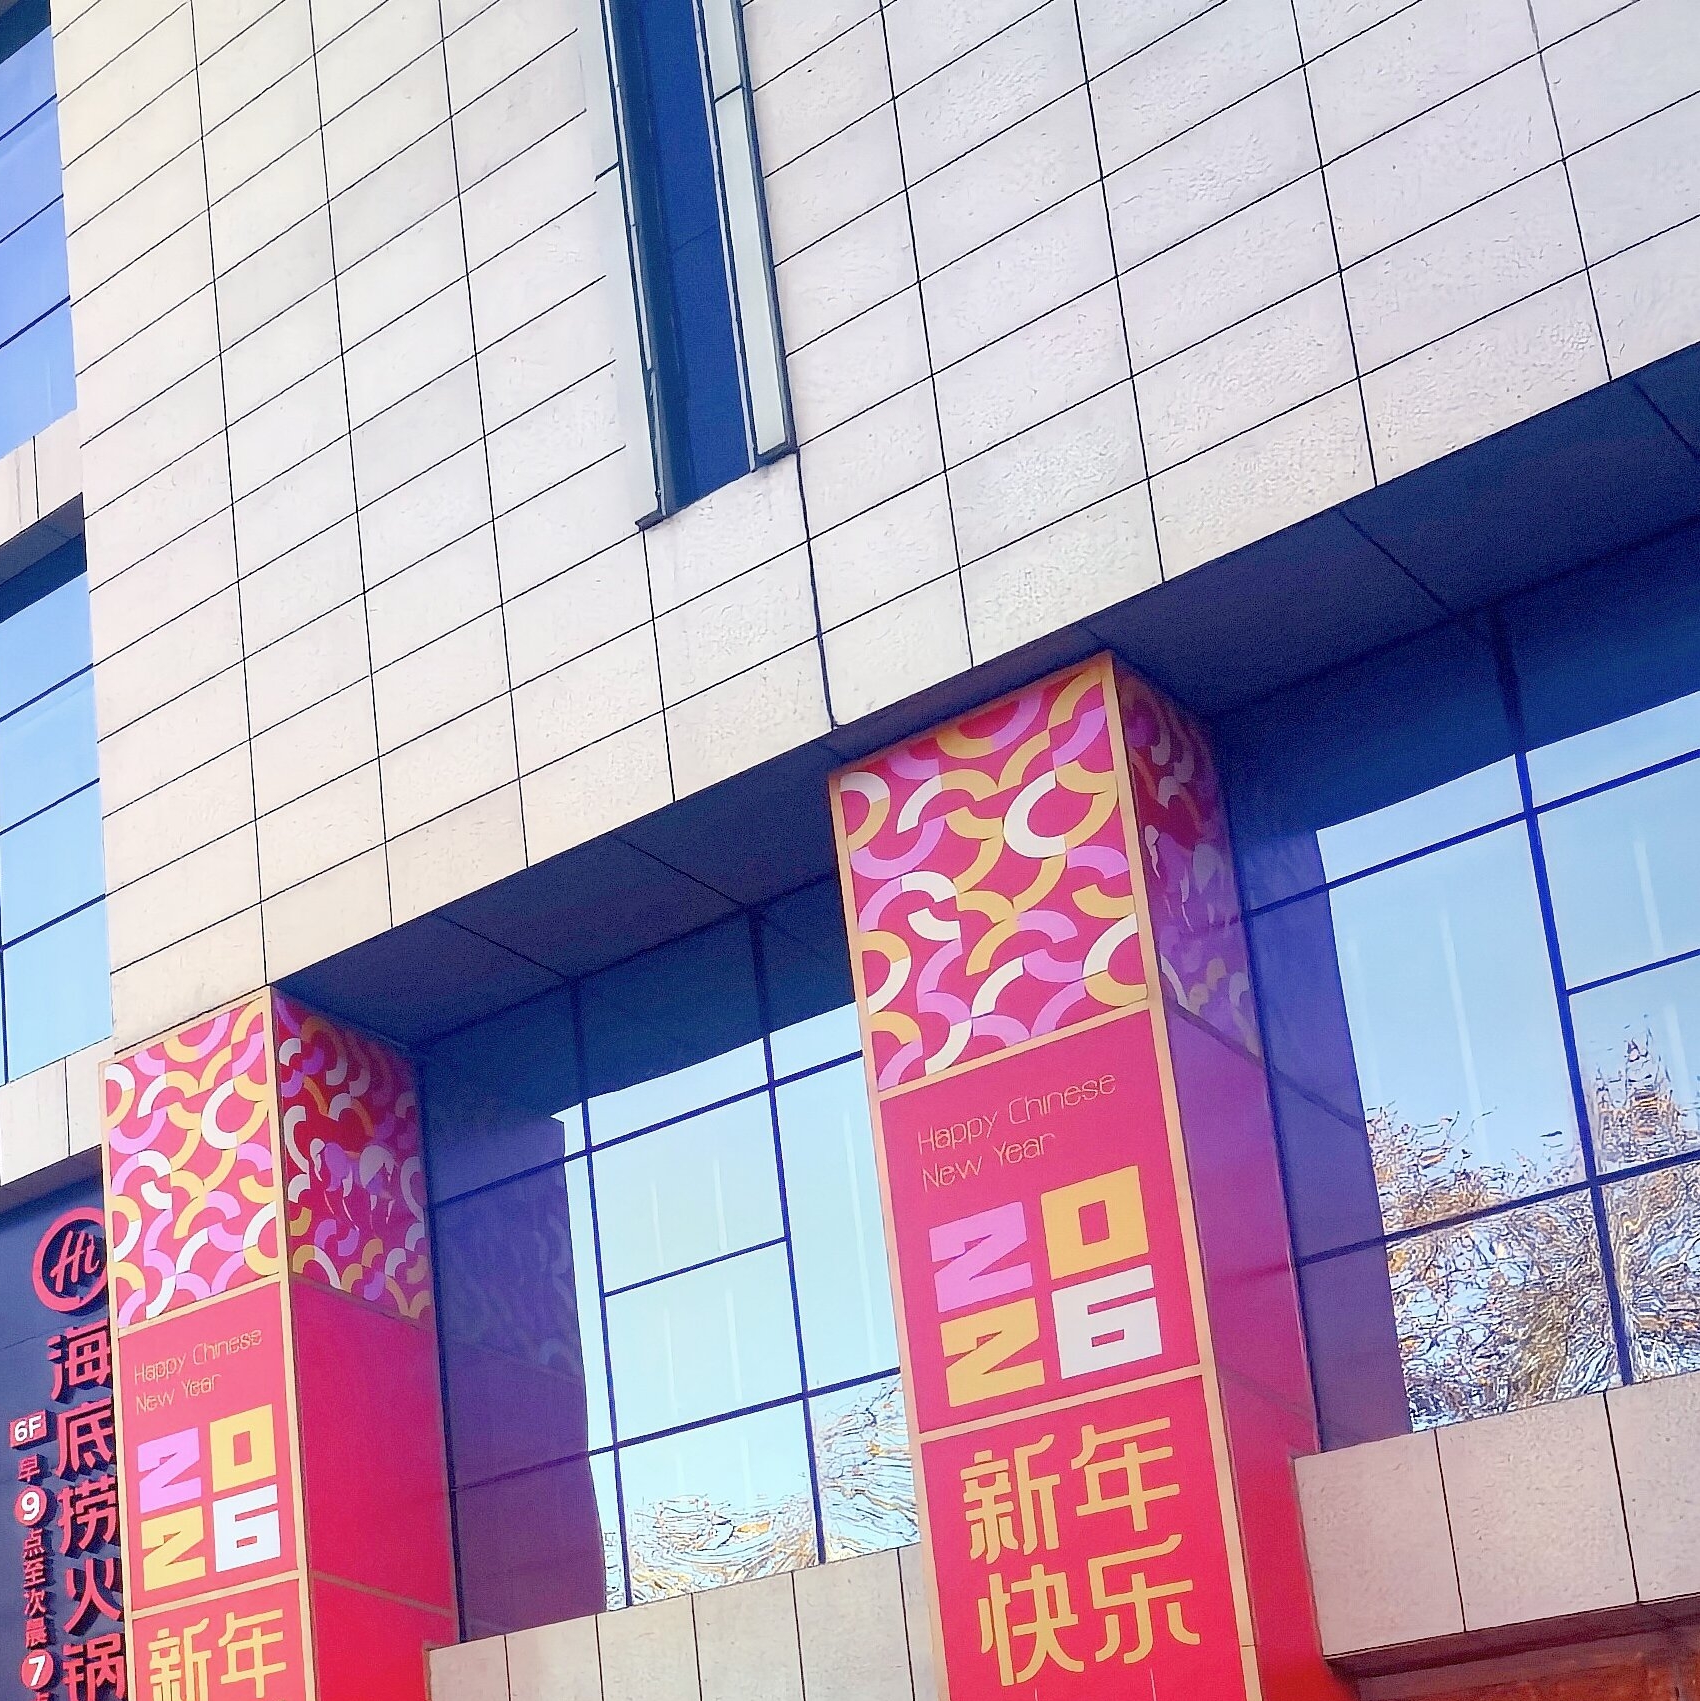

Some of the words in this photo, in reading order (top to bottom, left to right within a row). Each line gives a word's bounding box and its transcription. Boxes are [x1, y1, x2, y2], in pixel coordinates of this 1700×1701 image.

[917, 1110, 998, 1155] Happy
[1007, 1074, 1116, 1124] Chinese
[922, 1156, 983, 1192] New
[993, 1132, 1056, 1167] Year
[49, 1227, 100, 1282] Hi
[134, 1352, 187, 1386] Happy
[192, 1329, 262, 1365] Chinese
[136, 1388, 175, 1415] New
[181, 1373, 222, 1398] Year
[15, 1417, 45, 1443] 6F
[960, 1416, 1181, 1566] 新年
[976, 1532, 1202, 1687] 快乐
